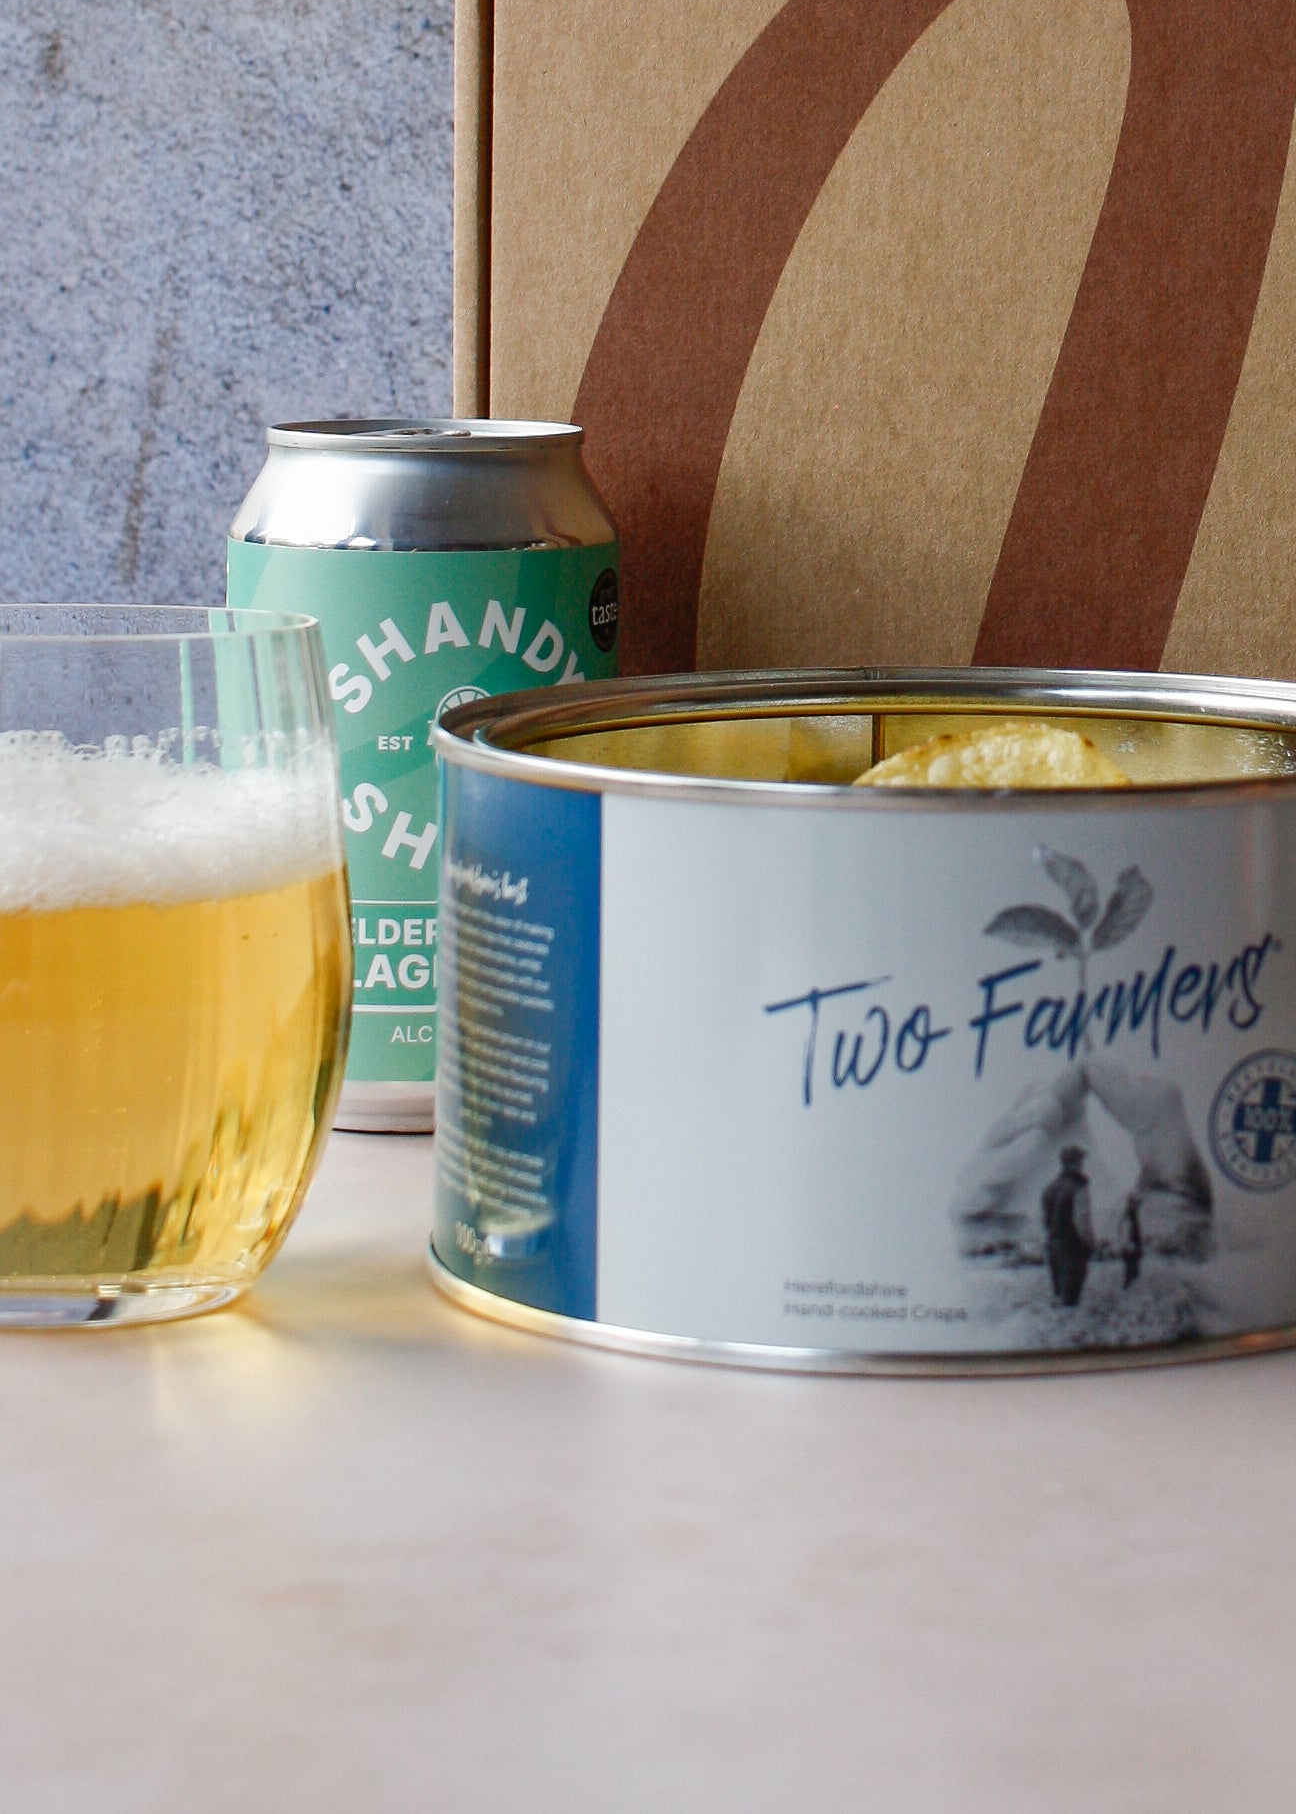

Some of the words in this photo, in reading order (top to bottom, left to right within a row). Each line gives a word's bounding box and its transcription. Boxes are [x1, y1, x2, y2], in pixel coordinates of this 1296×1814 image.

[328, 599, 586, 714] SHANDY
[377, 735, 414, 752] EST
[764, 975, 951, 1107] Two
[969, 933, 1275, 1080] Farmers
